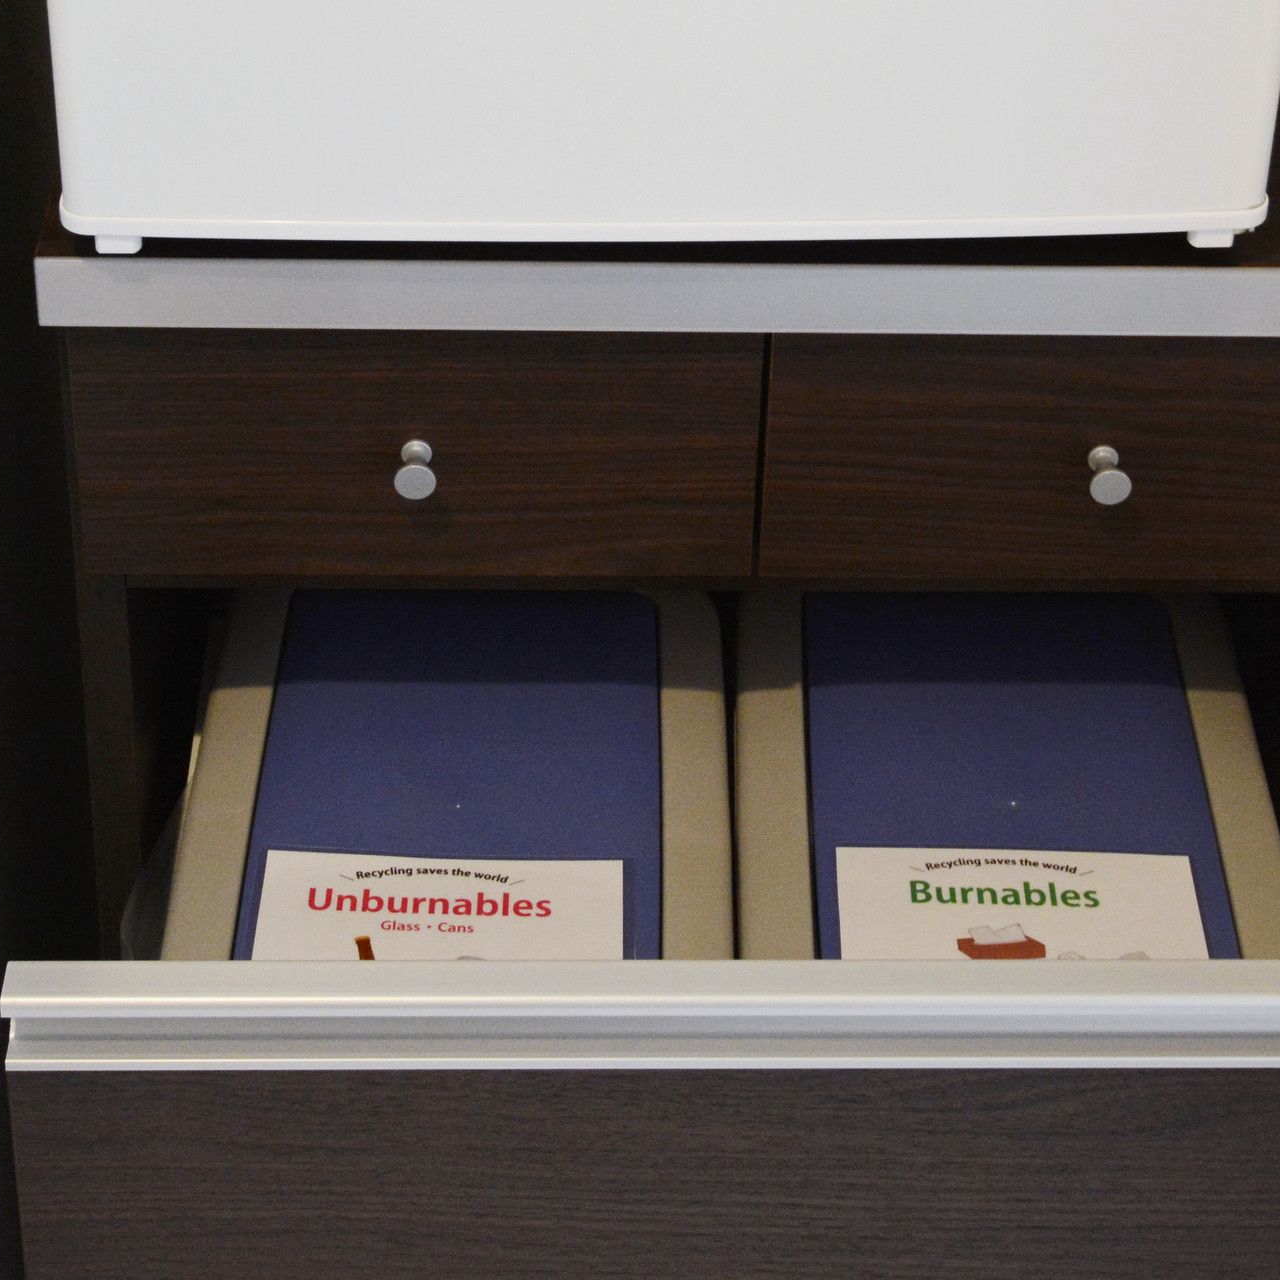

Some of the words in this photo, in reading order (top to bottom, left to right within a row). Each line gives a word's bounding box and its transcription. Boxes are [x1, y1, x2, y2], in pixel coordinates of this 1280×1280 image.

[925, 858, 982, 871] Recycling
[984, 858, 1017, 866] saves
[1019, 858, 1040, 868] the
[1042, 862, 1078, 875] world
[356, 867, 413, 880] Recycling
[416, 868, 449, 876] saves
[452, 867, 472, 878] the
[474, 871, 509, 884] world
[307, 887, 552, 917] Unburnables
[909, 880, 1101, 908] Burnables
[380, 920, 421, 931] Glass
[437, 922, 475, 934] Cans
